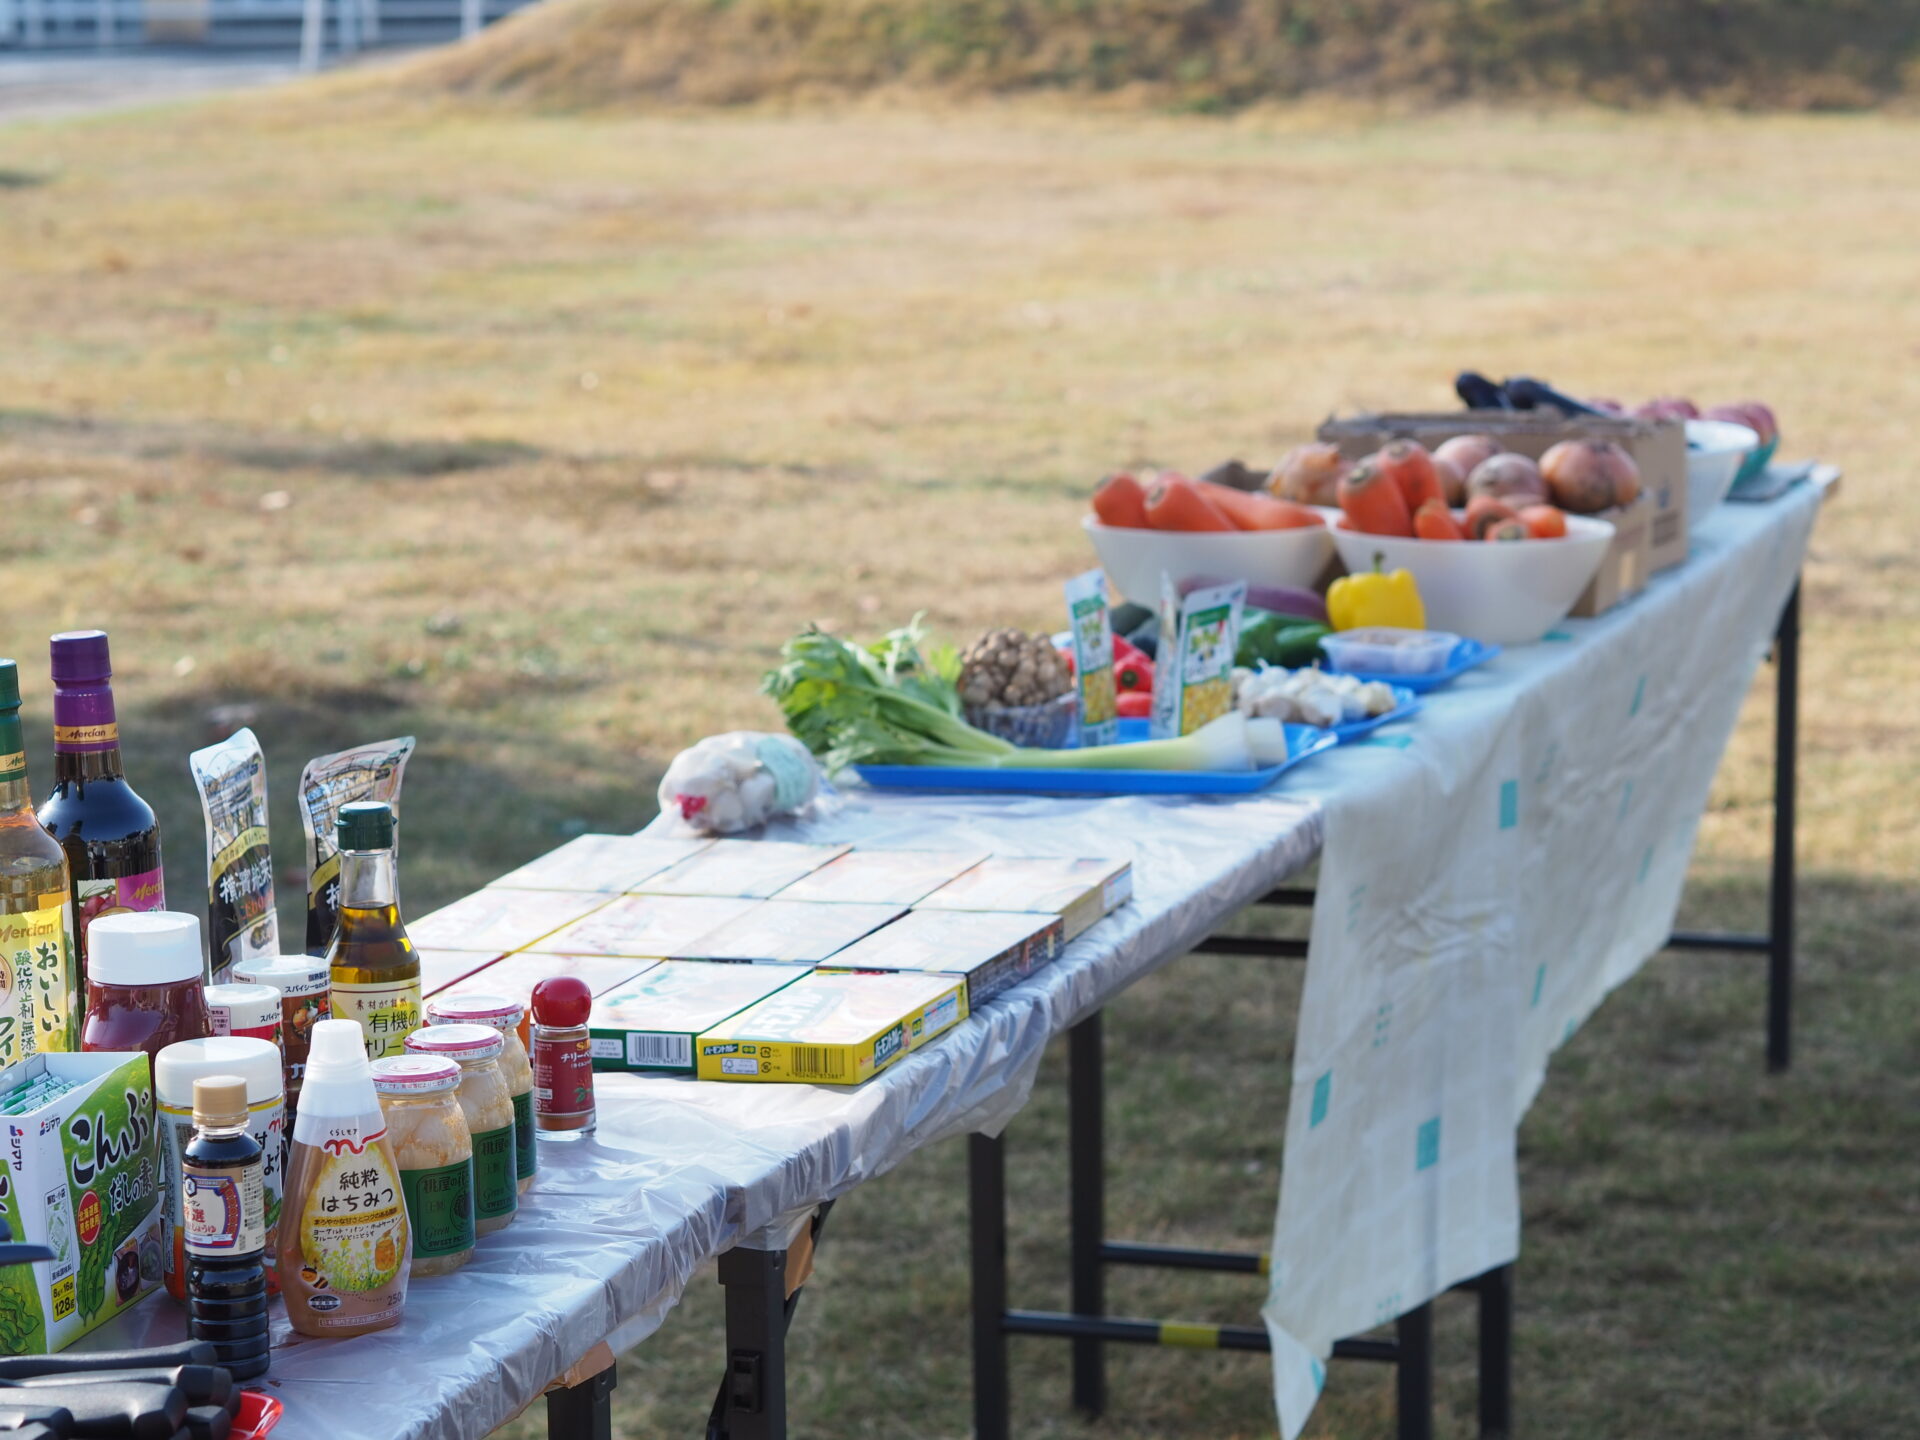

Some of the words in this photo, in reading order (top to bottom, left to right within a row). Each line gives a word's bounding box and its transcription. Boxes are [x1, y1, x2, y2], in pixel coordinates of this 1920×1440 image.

[66, 727, 106, 739] Mercian
[36, 942, 60, 1032] おいしい
[368, 1009, 419, 1033] 有機の
[365, 1037, 406, 1057] オリー
[71, 1092, 149, 1185] こんぶ
[11, 1138, 22, 1171] シマヤ
[109, 1158, 153, 1215] だしの素
[339, 1168, 379, 1190] 純粋
[321, 1187, 393, 1212] はちみつ
